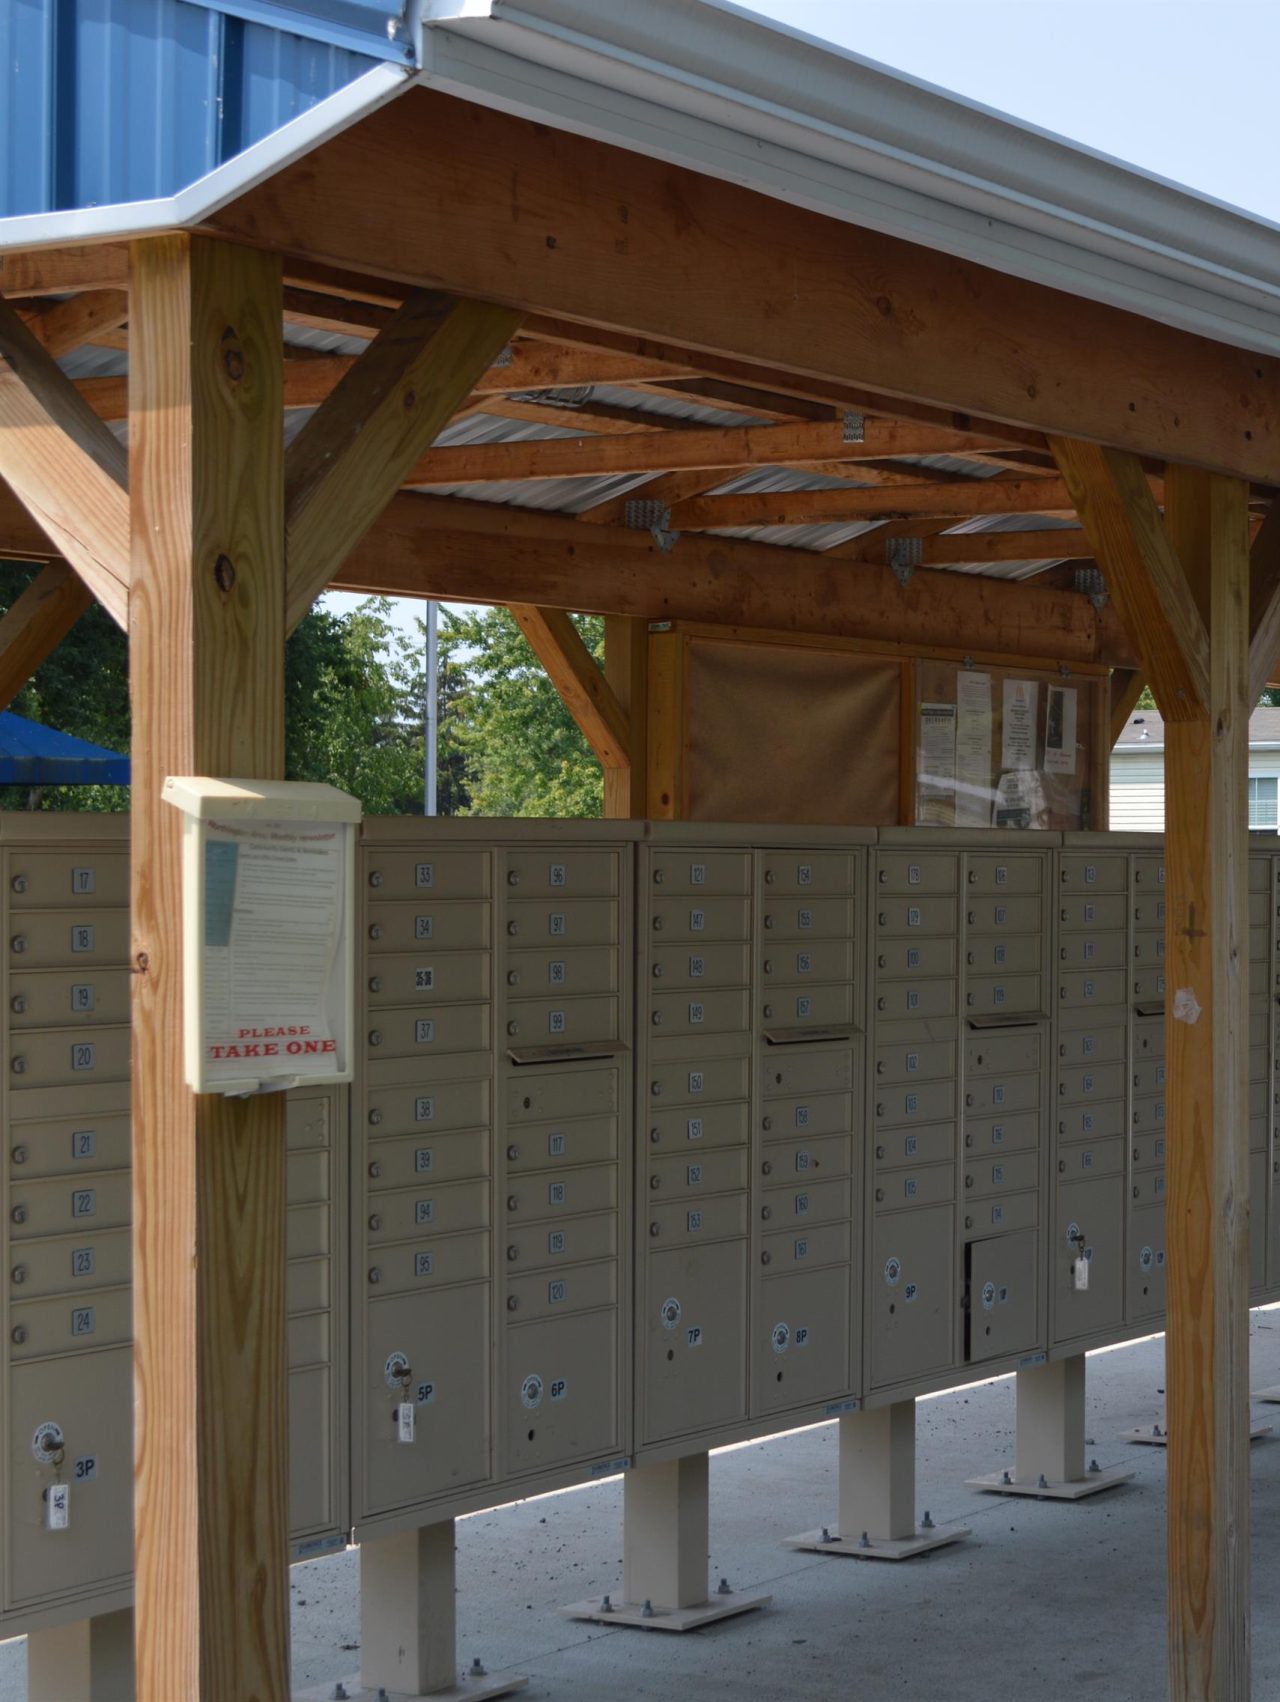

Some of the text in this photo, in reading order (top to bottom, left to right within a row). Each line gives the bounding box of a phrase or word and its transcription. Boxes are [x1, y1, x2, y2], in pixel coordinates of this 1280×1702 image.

[79, 872, 89, 889] 17
[419, 867, 431, 883] 33
[419, 919, 430, 936] 34
[78, 930, 89, 948] 18
[78, 988, 89, 1006] 19
[239, 1025, 311, 1039] PLEASE
[420, 1022, 431, 1039] 37
[77, 1046, 91, 1066] 20
[210, 1039, 337, 1059] TAKE ONE
[419, 1101, 431, 1118] 38
[80, 1135, 90, 1154] 21
[419, 1152, 431, 1169] 39
[79, 1194, 91, 1213] 22
[419, 1203, 431, 1220] 94
[78, 1253, 91, 1272] 23
[419, 1255, 431, 1272] 95
[905, 1285, 917, 1300] 9P
[77, 1312, 90, 1330] 24
[687, 1328, 700, 1345] 7P
[417, 1384, 433, 1402] 5P
[551, 1380, 565, 1398] 6P
[75, 1459, 95, 1479] 3P
